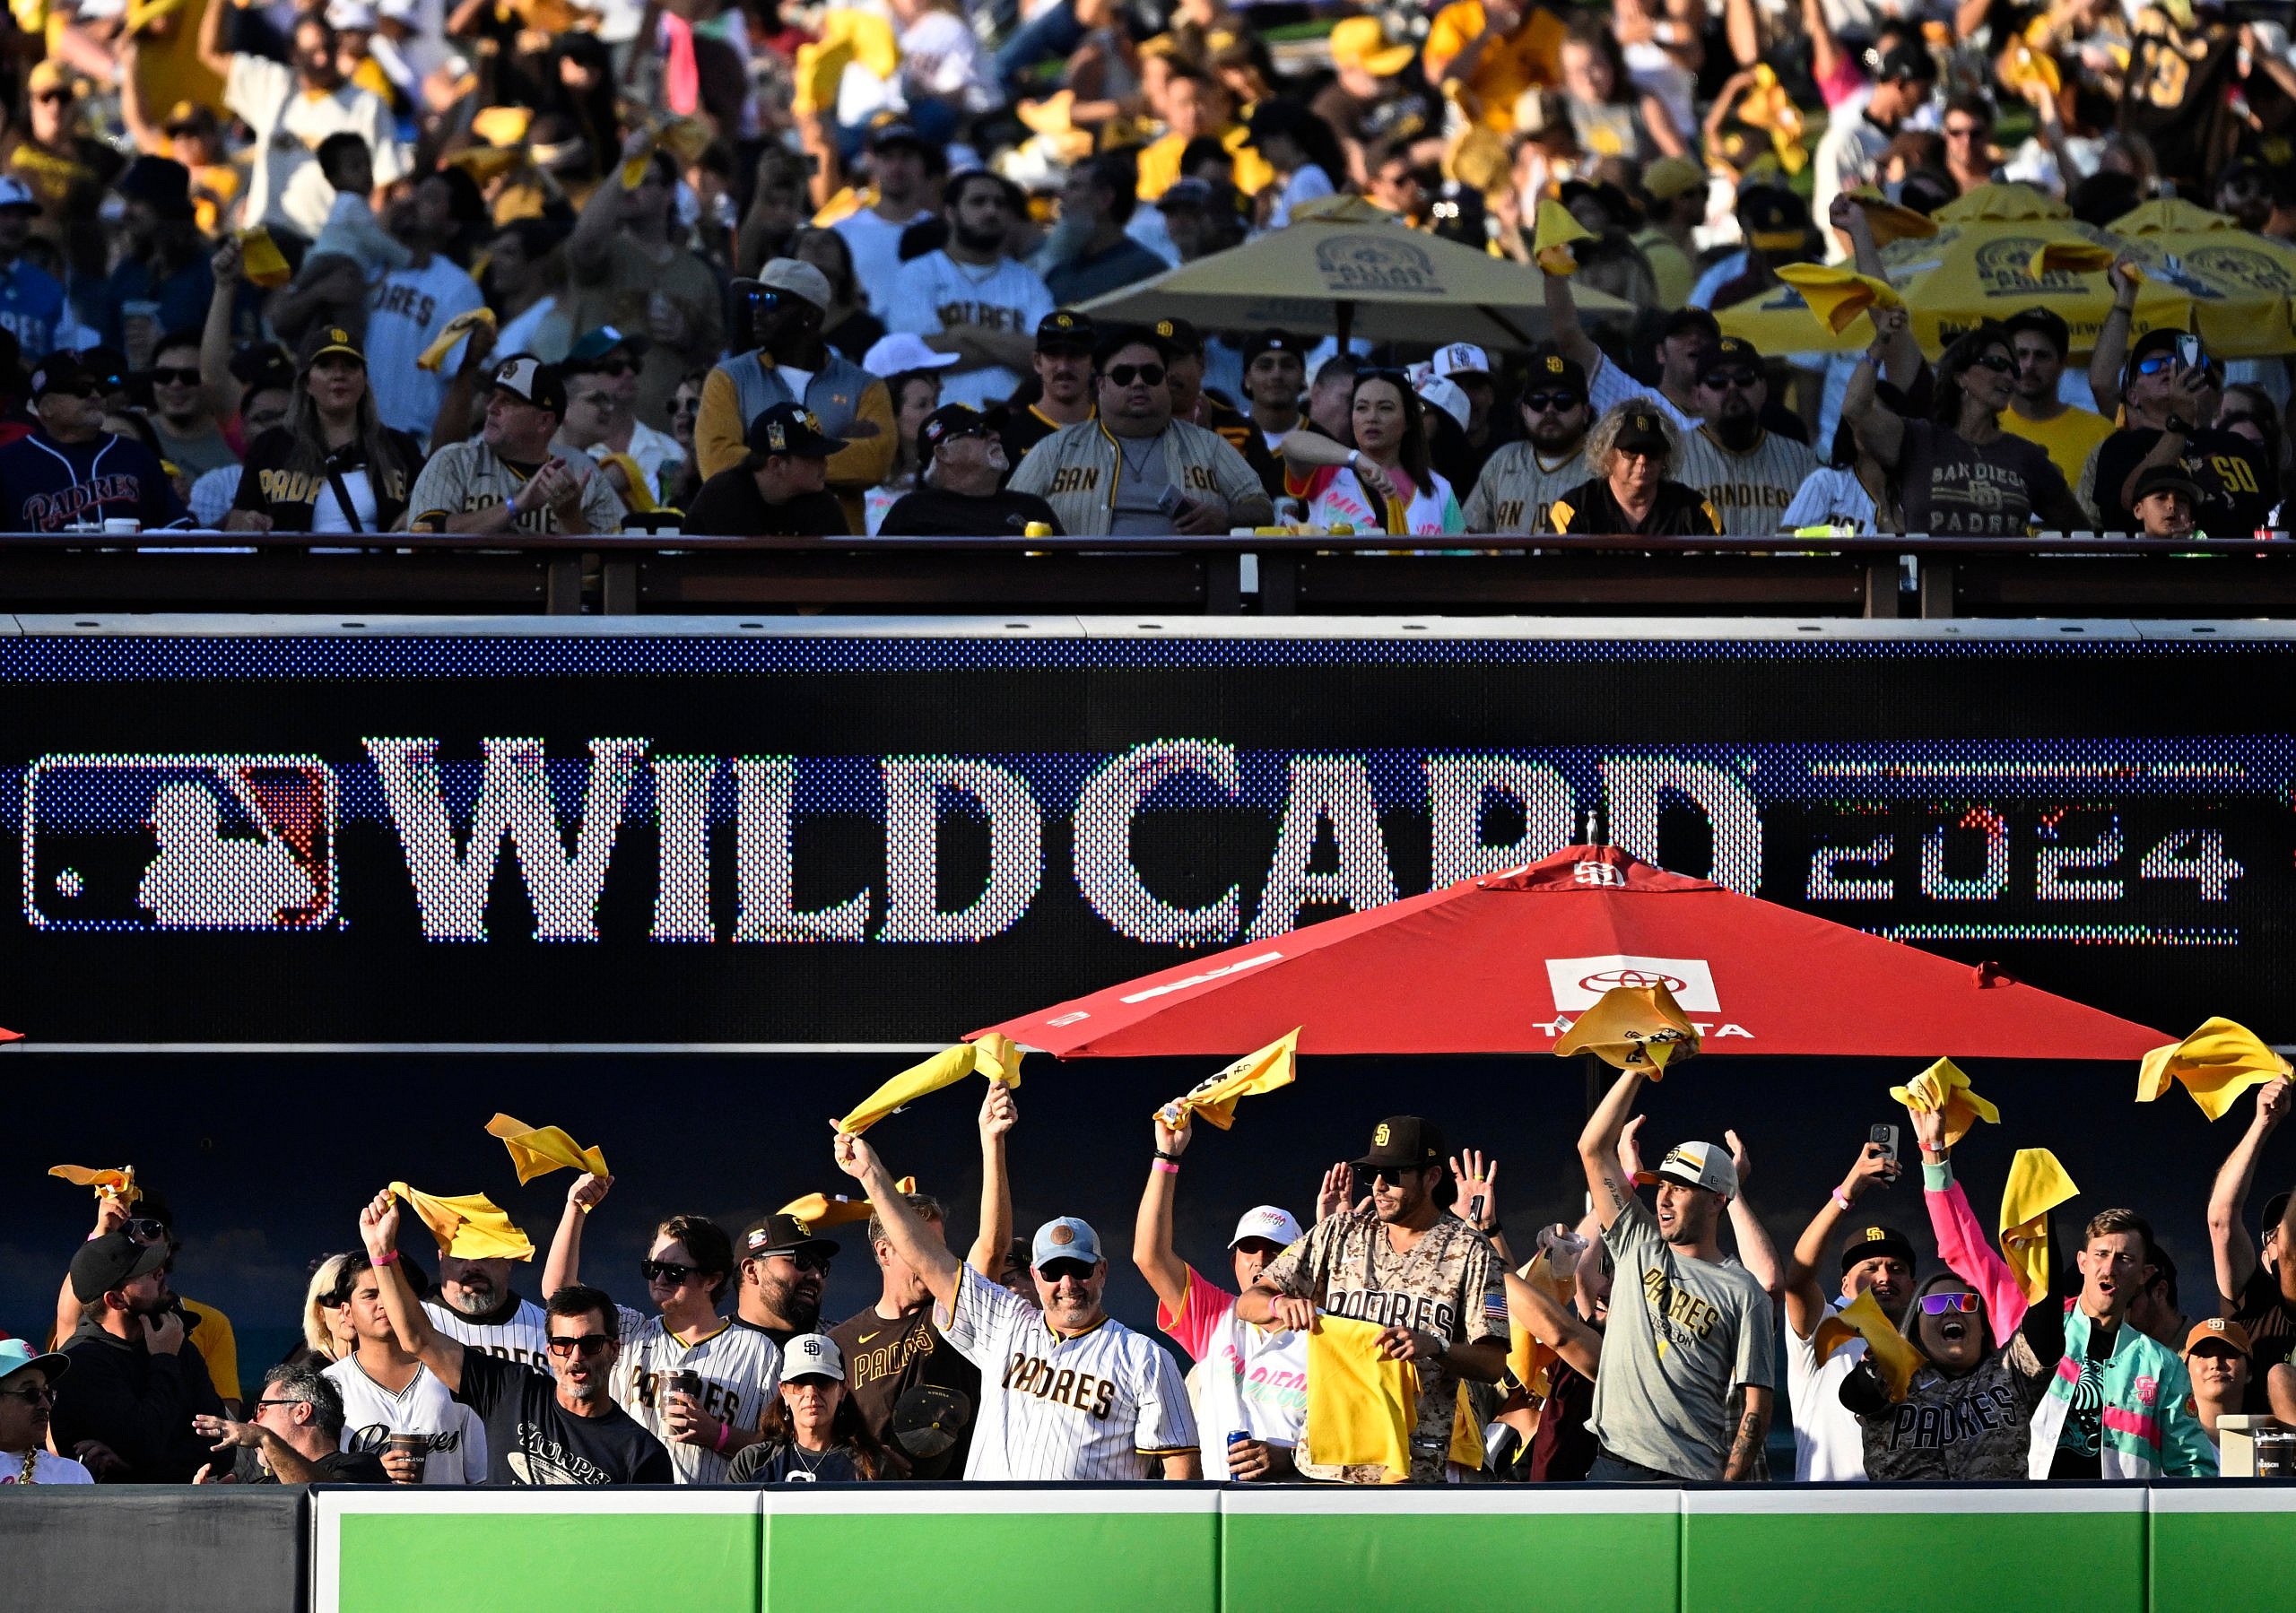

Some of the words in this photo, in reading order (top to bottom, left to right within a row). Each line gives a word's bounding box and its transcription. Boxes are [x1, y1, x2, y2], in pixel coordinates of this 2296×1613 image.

[1545, 356, 1564, 373] SD
[1051, 464, 1100, 495] SAN
[1183, 466, 1221, 494] EGO
[1932, 462, 1968, 483] SAN
[2211, 455, 2258, 494] SD
[23, 473, 140, 533] PADRES
[1496, 500, 1524, 528] AN
[1930, 510, 2027, 534] PADRE
[361, 735, 1046, 943] WILD
[1071, 736, 1763, 949] CARD
[1805, 807, 2244, 901] 2024
[1531, 1022, 1756, 1039] TTA
[1376, 1123, 1391, 1147] SD
[1866, 1227, 1886, 1242] SD
[1326, 1288, 1454, 1343] PADRES
[1642, 1267, 1719, 1341] PARES
[804, 1340, 820, 1356] SD
[631, 1365, 741, 1427] PAES
[1001, 1351, 1116, 1421] PADRES
[2135, 1375, 2159, 1407] SD
[1887, 1384, 2018, 1453] PADRES
